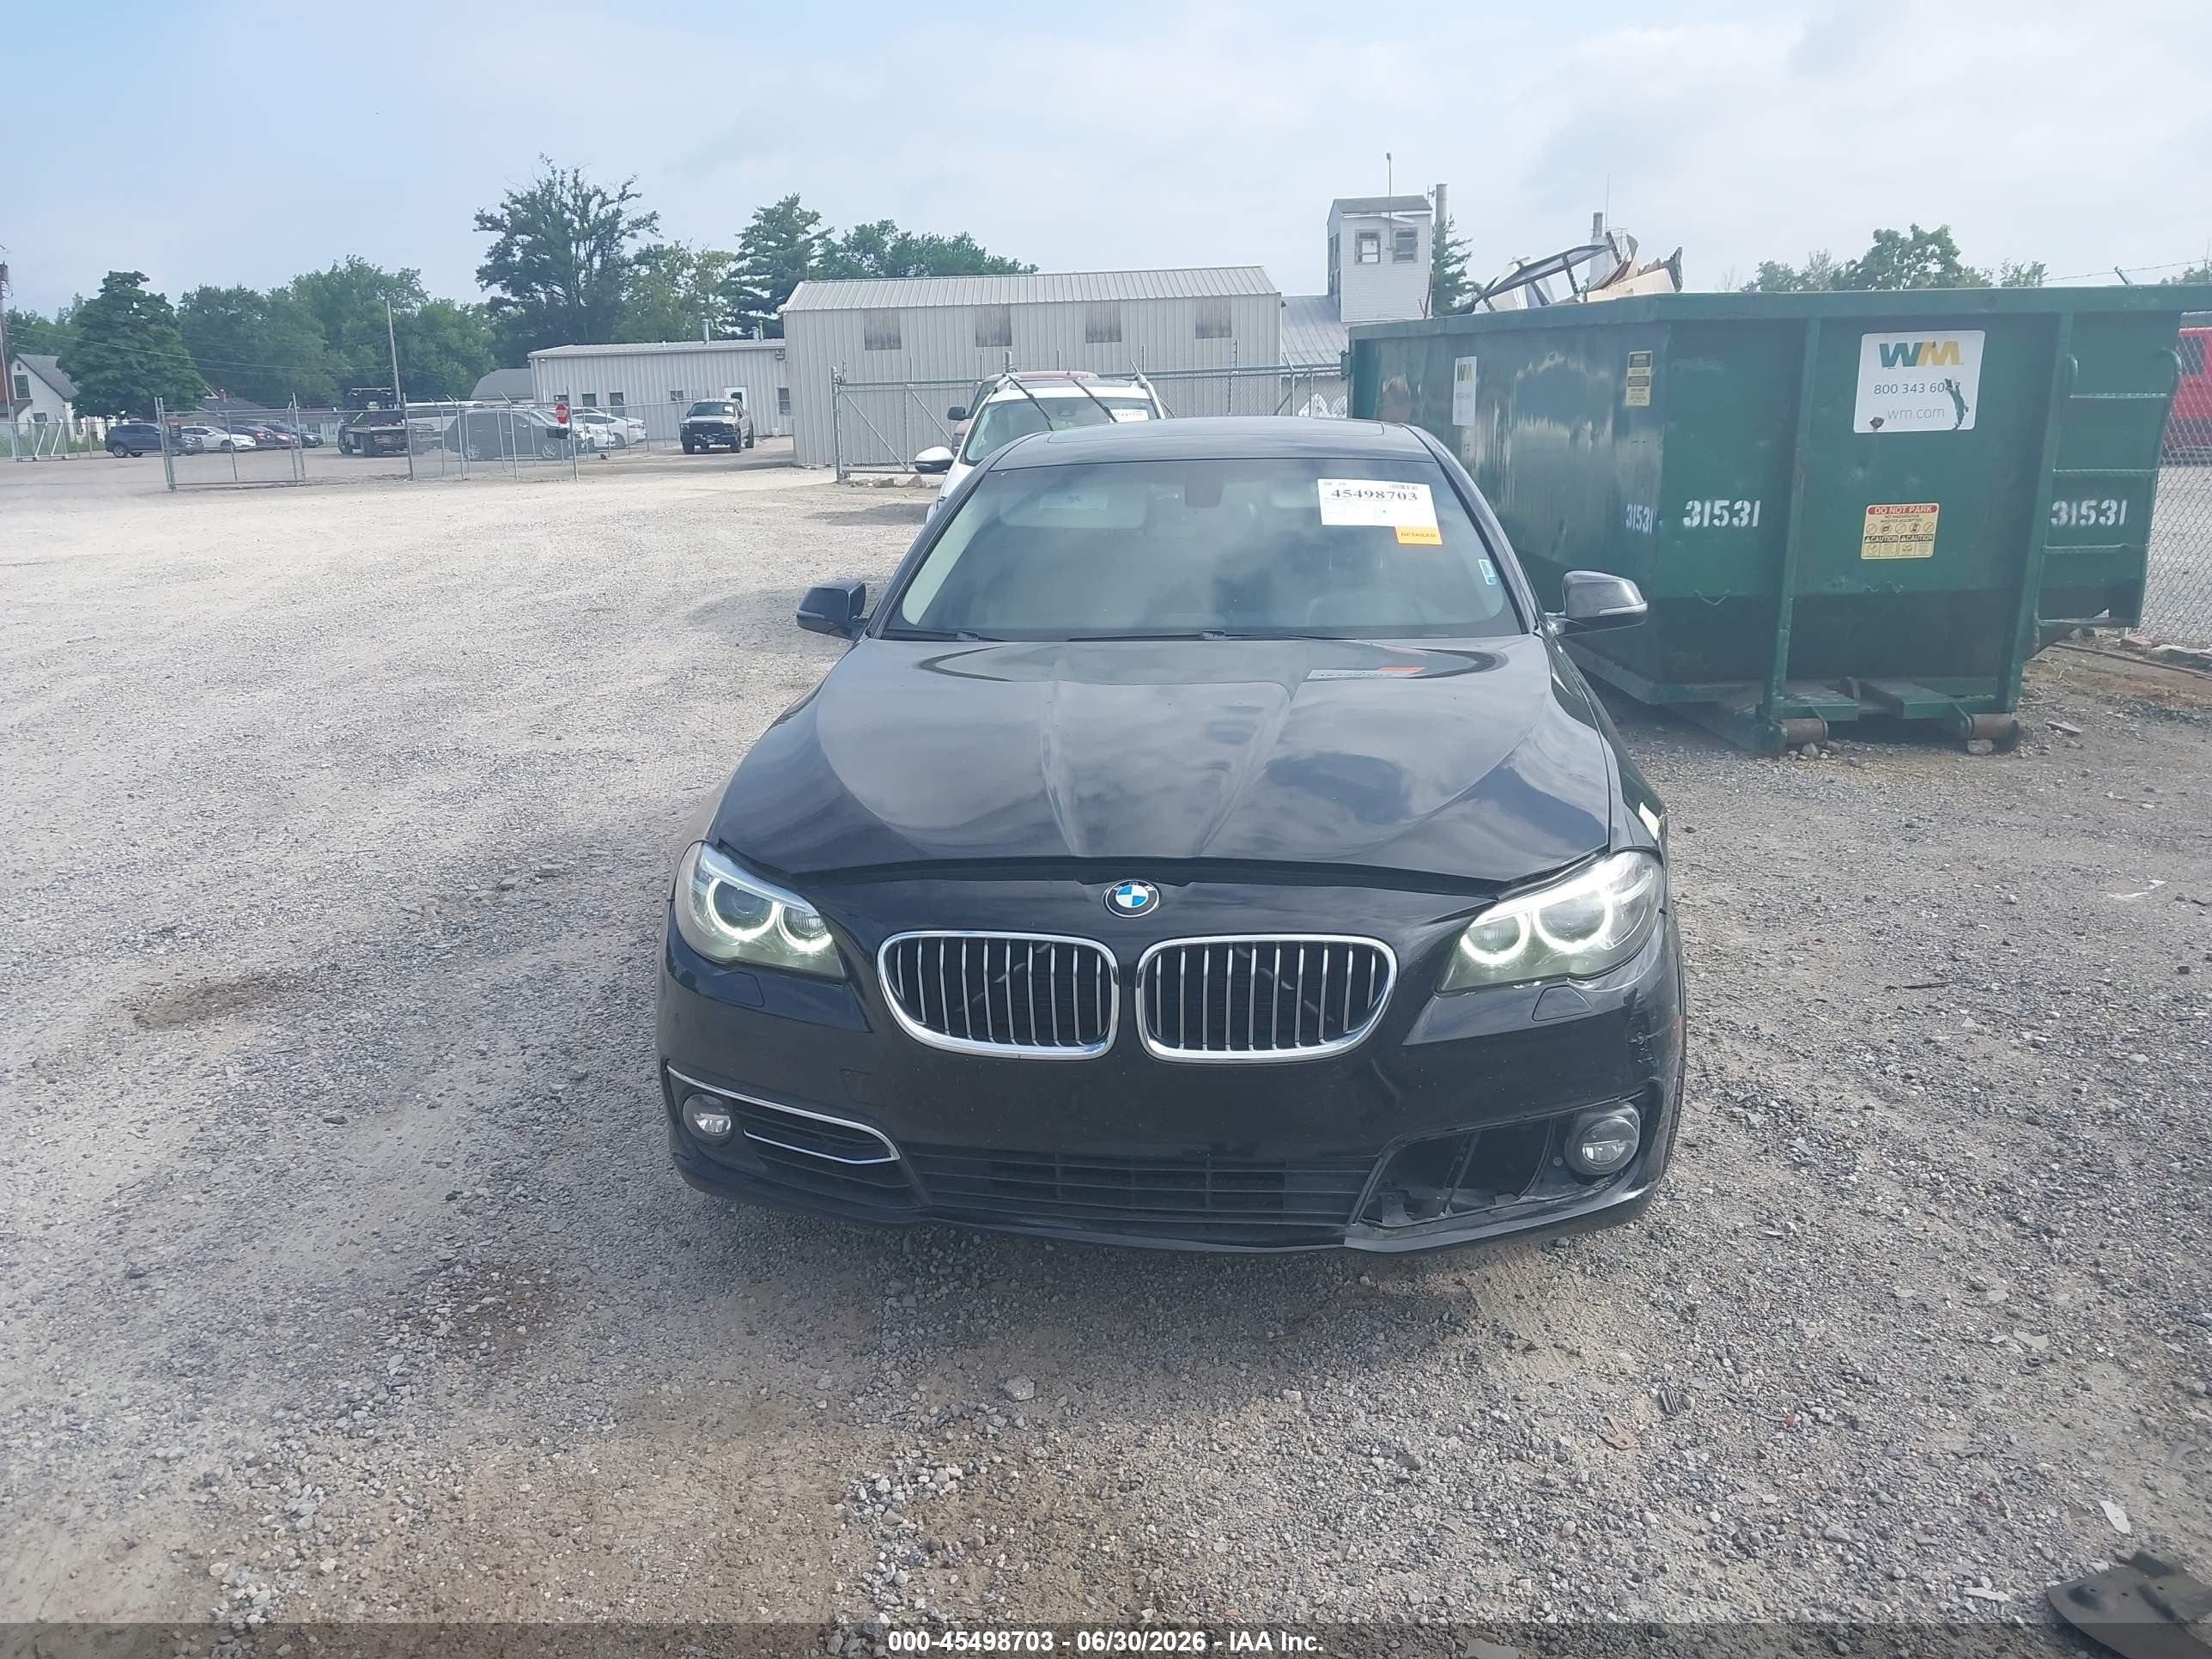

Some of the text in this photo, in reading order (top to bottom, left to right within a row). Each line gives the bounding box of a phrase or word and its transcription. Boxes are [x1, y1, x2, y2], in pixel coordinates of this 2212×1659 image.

[1879, 341, 1961, 368] WM
[1874, 384, 1898, 394] 800
[1902, 383, 1925, 393] 343
[1887, 408, 1944, 420] wm.com
[1331, 489, 1418, 501] 45498703
[1626, 503, 1654, 534] 31531
[1683, 500, 1761, 527] 31531
[2051, 499, 2128, 526] 31531
